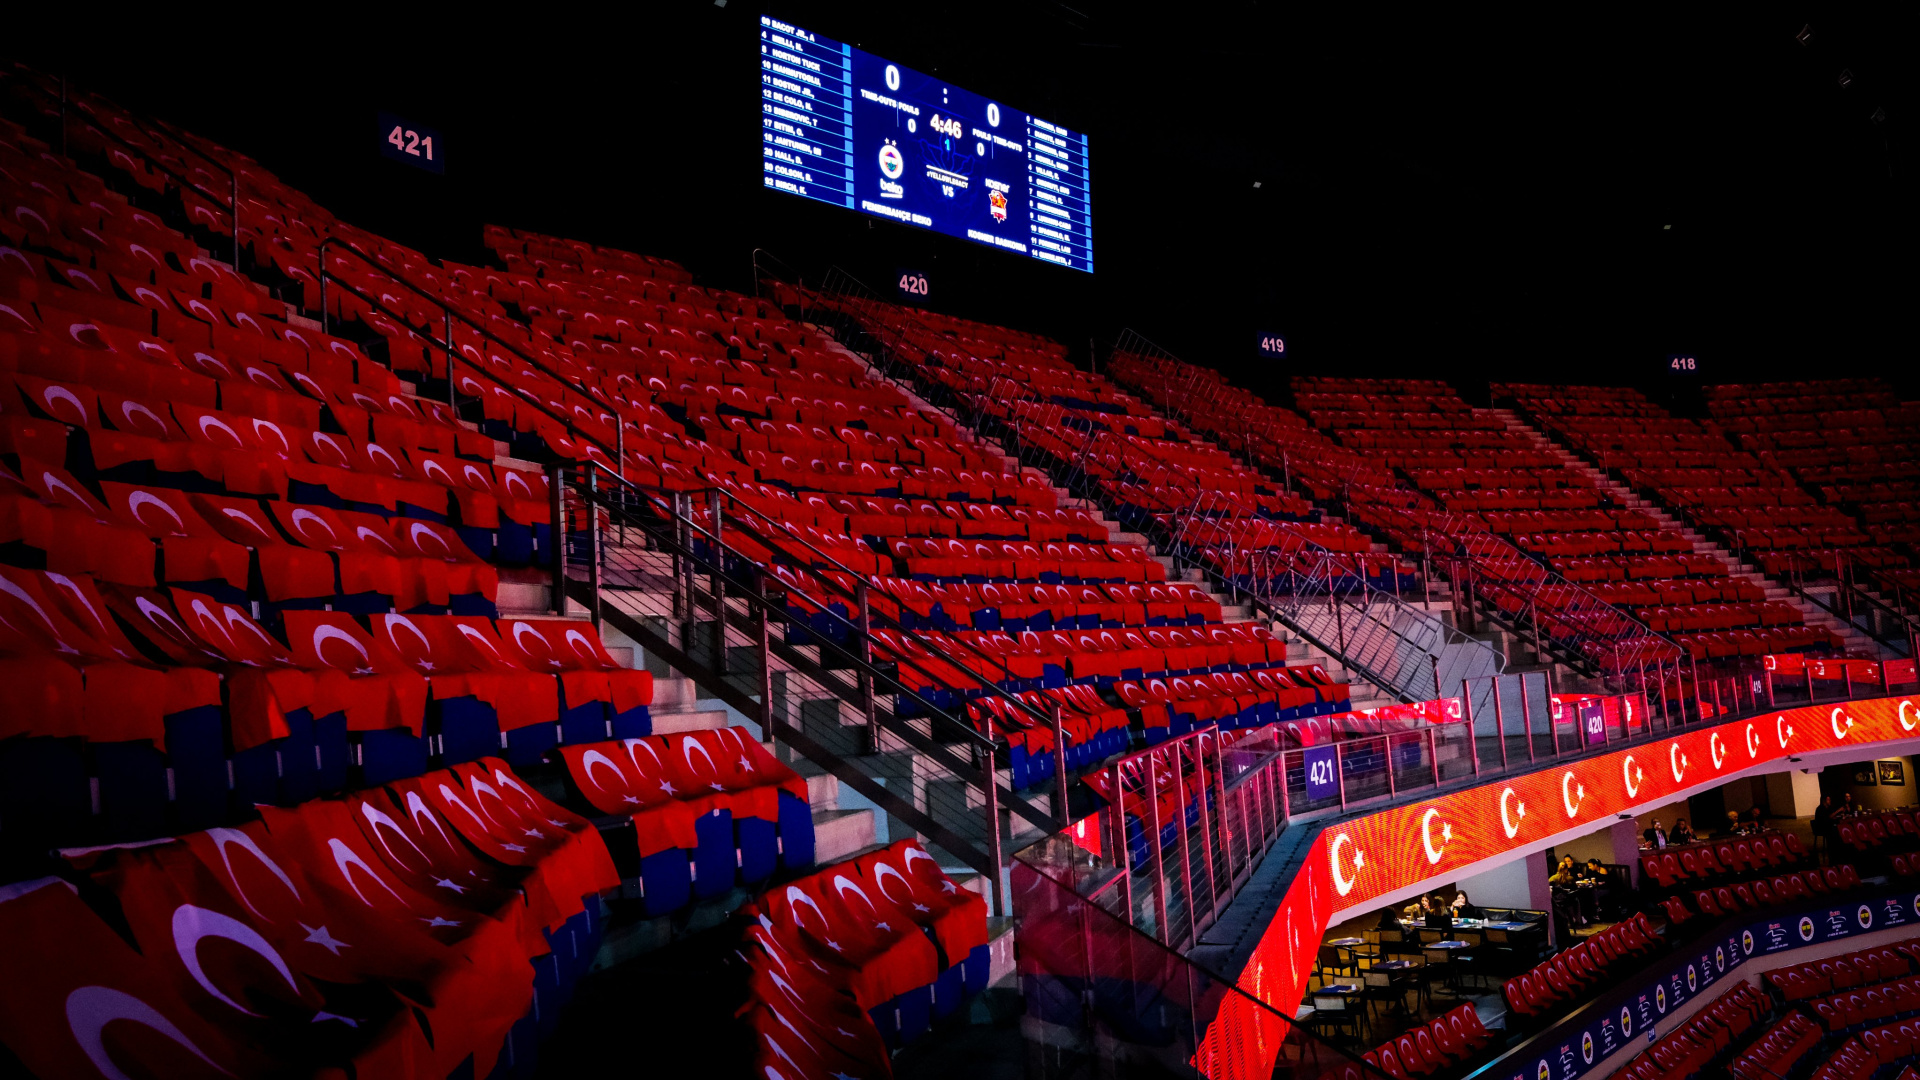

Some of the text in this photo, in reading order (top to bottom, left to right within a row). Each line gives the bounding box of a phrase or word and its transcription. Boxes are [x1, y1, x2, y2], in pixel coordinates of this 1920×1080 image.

[761, 31, 767, 39] 4
[809, 34, 815, 42] A
[762, 60, 771, 69] 10
[772, 48, 801, 65] HORTON
[762, 74, 771, 84] 11
[885, 65, 900, 91] 0
[763, 89, 772, 98] 12
[860, 89, 920, 116] TIME-OUTS FOULS
[764, 118, 772, 127] 17
[987, 103, 1000, 128] 0
[908, 118, 916, 133] 0
[930, 114, 962, 139] 4:46
[388, 125, 433, 161] 421
[944, 139, 950, 151] 1
[972, 128, 992, 142] FOULS
[993, 136, 1022, 152] TIME-OUTS
[764, 147, 774, 157] 20
[976, 142, 984, 157] 0
[880, 178, 904, 195] beko
[942, 184, 954, 198] VS
[862, 200, 932, 226] FENERBAHÇE BEKO
[899, 274, 928, 296] 420
[1261, 336, 1284, 353] 419
[1671, 357, 1696, 370] 418
[1588, 715, 1603, 735] 420
[1310, 758, 1334, 786] 421
